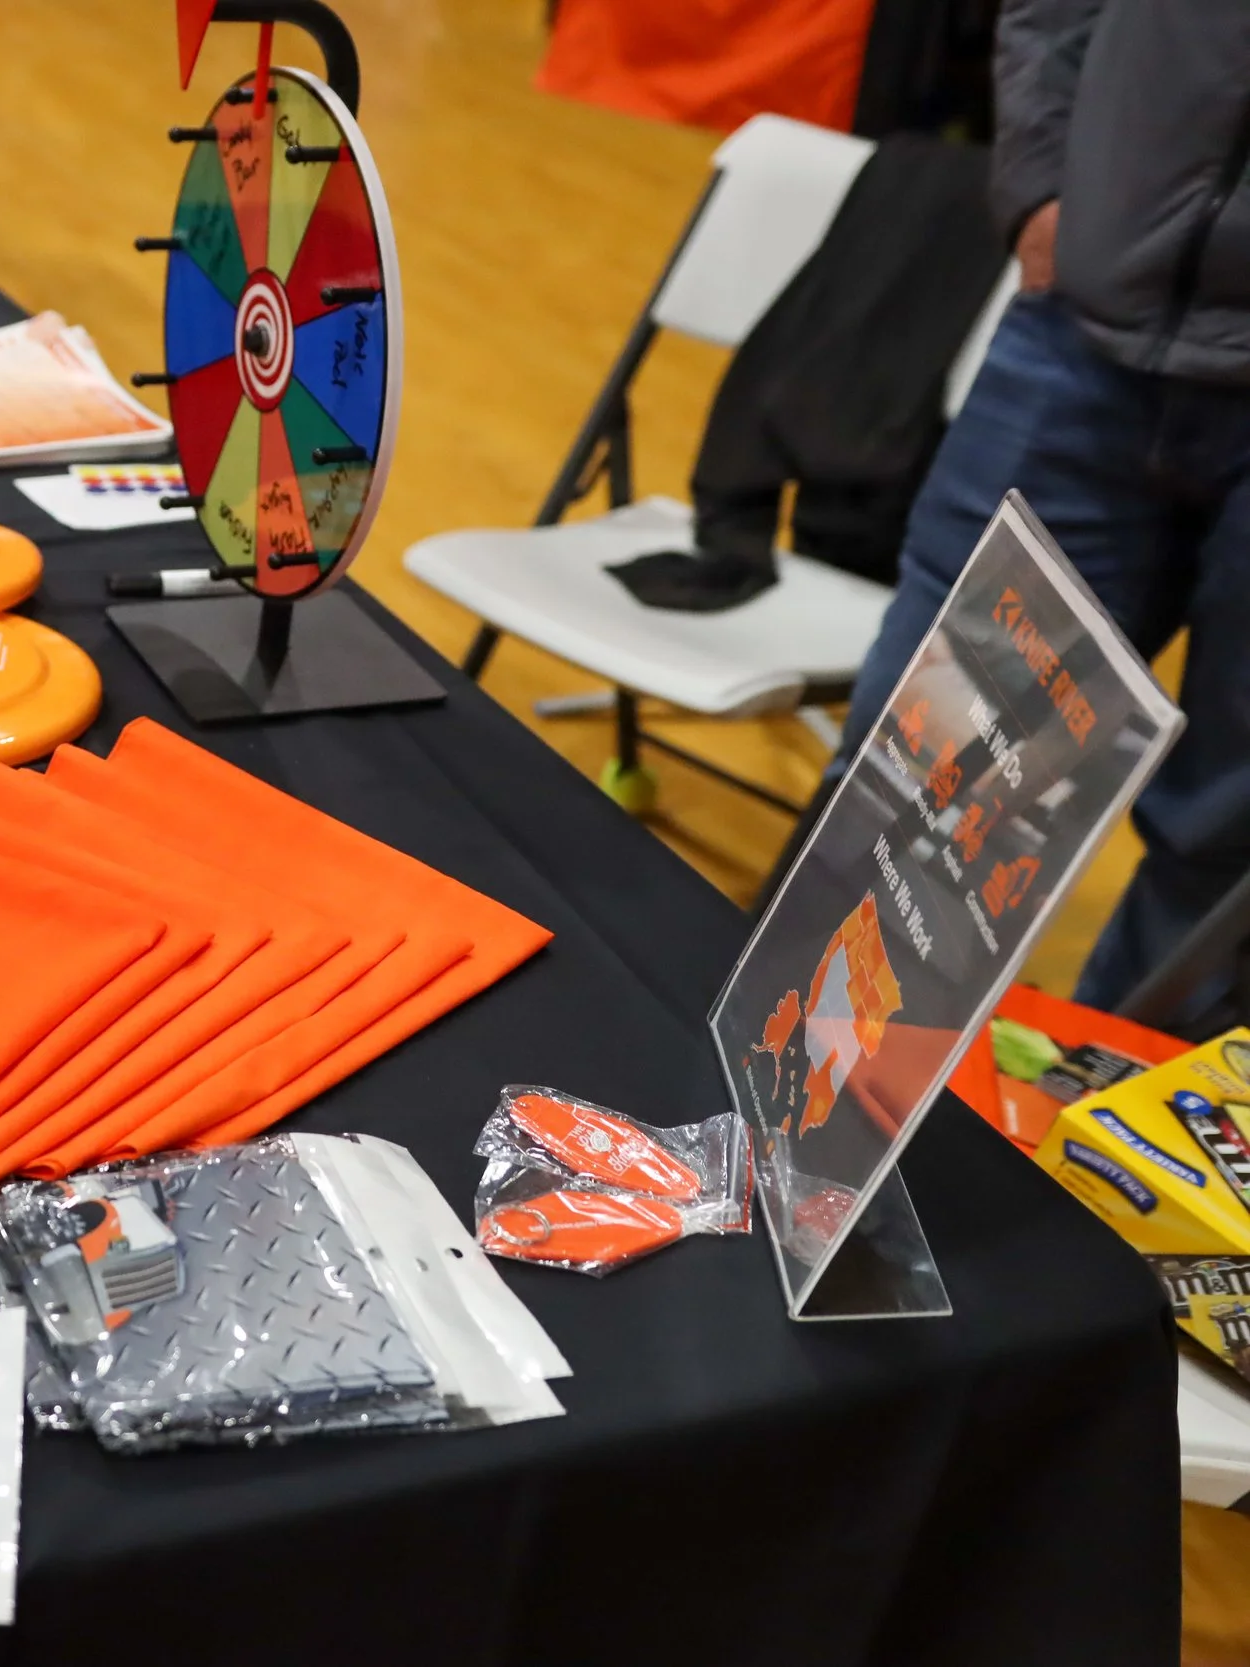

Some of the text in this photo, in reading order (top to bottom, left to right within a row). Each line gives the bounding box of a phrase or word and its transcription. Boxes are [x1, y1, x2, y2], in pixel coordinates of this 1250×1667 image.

[967, 692, 1023, 790] What We Do
[1011, 616, 1098, 749] KNIFE RIVER
[872, 832, 934, 961] Where We Work
